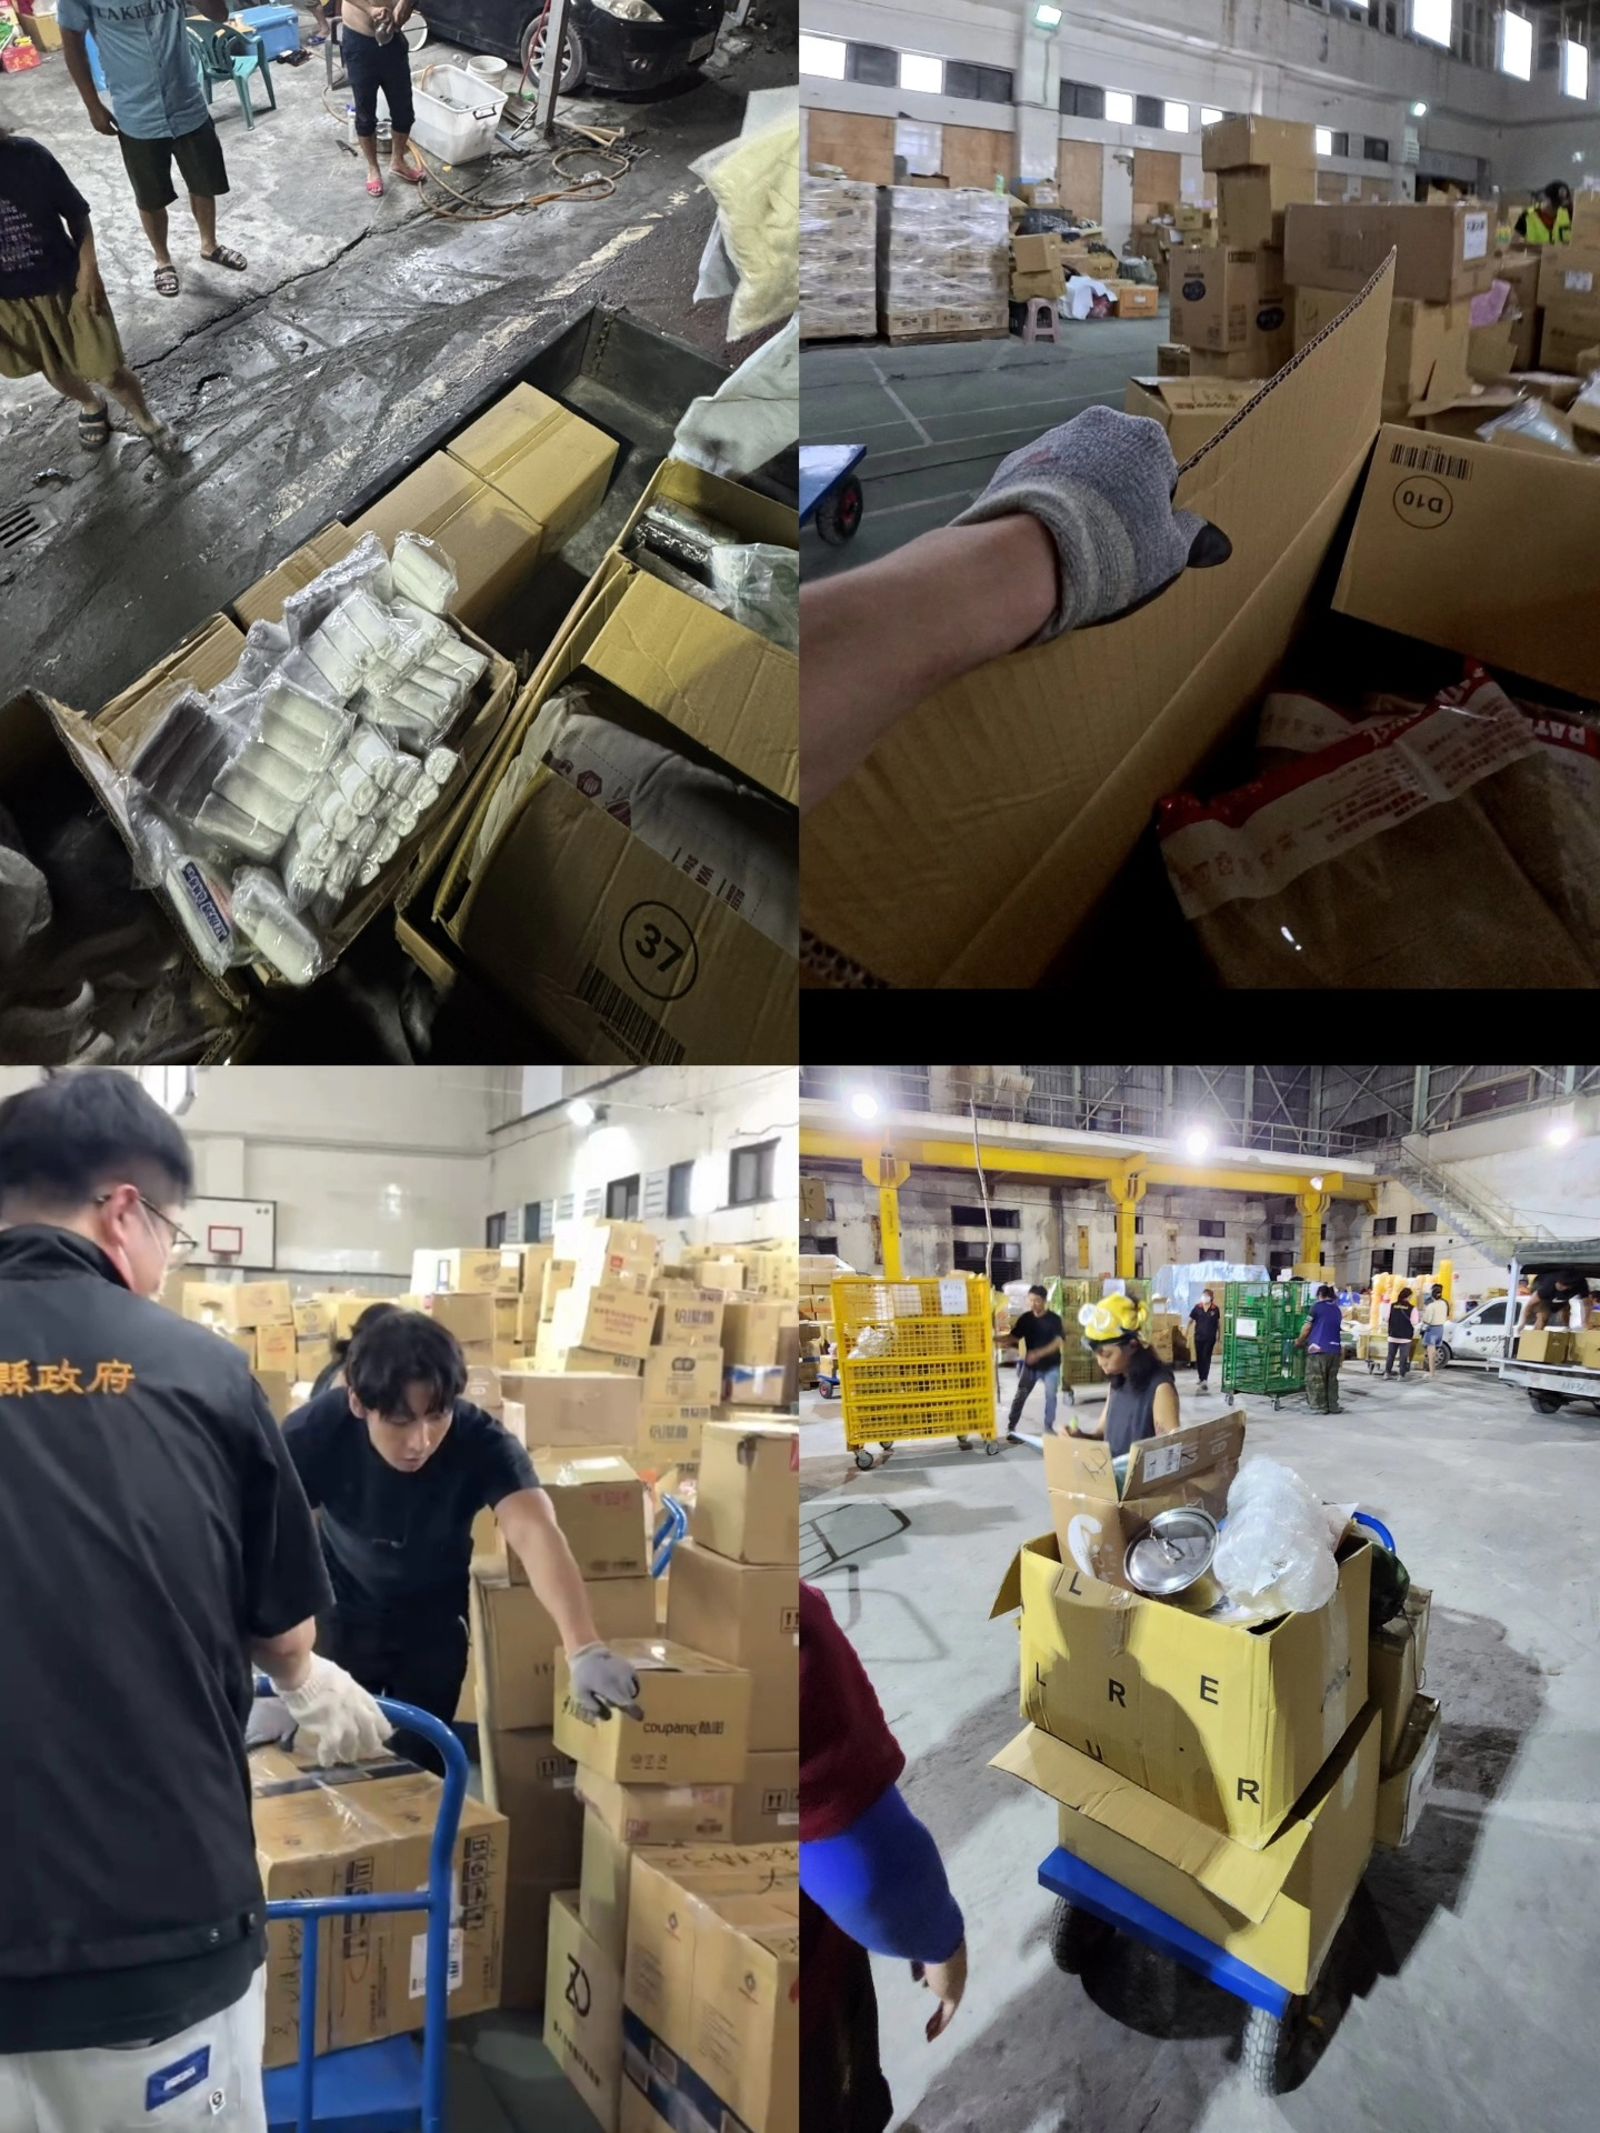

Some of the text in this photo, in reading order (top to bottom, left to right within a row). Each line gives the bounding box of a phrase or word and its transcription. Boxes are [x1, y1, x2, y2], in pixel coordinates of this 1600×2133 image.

[1402, 489, 1444, 514] D10
[635, 923, 685, 973] 37
[0, 1358, 136, 1398] 縣政府
[1108, 1677, 1127, 1708] R
[1199, 1674, 1220, 1706] E
[642, 1721, 697, 1737] coupang
[1236, 1775, 1261, 1805] R
